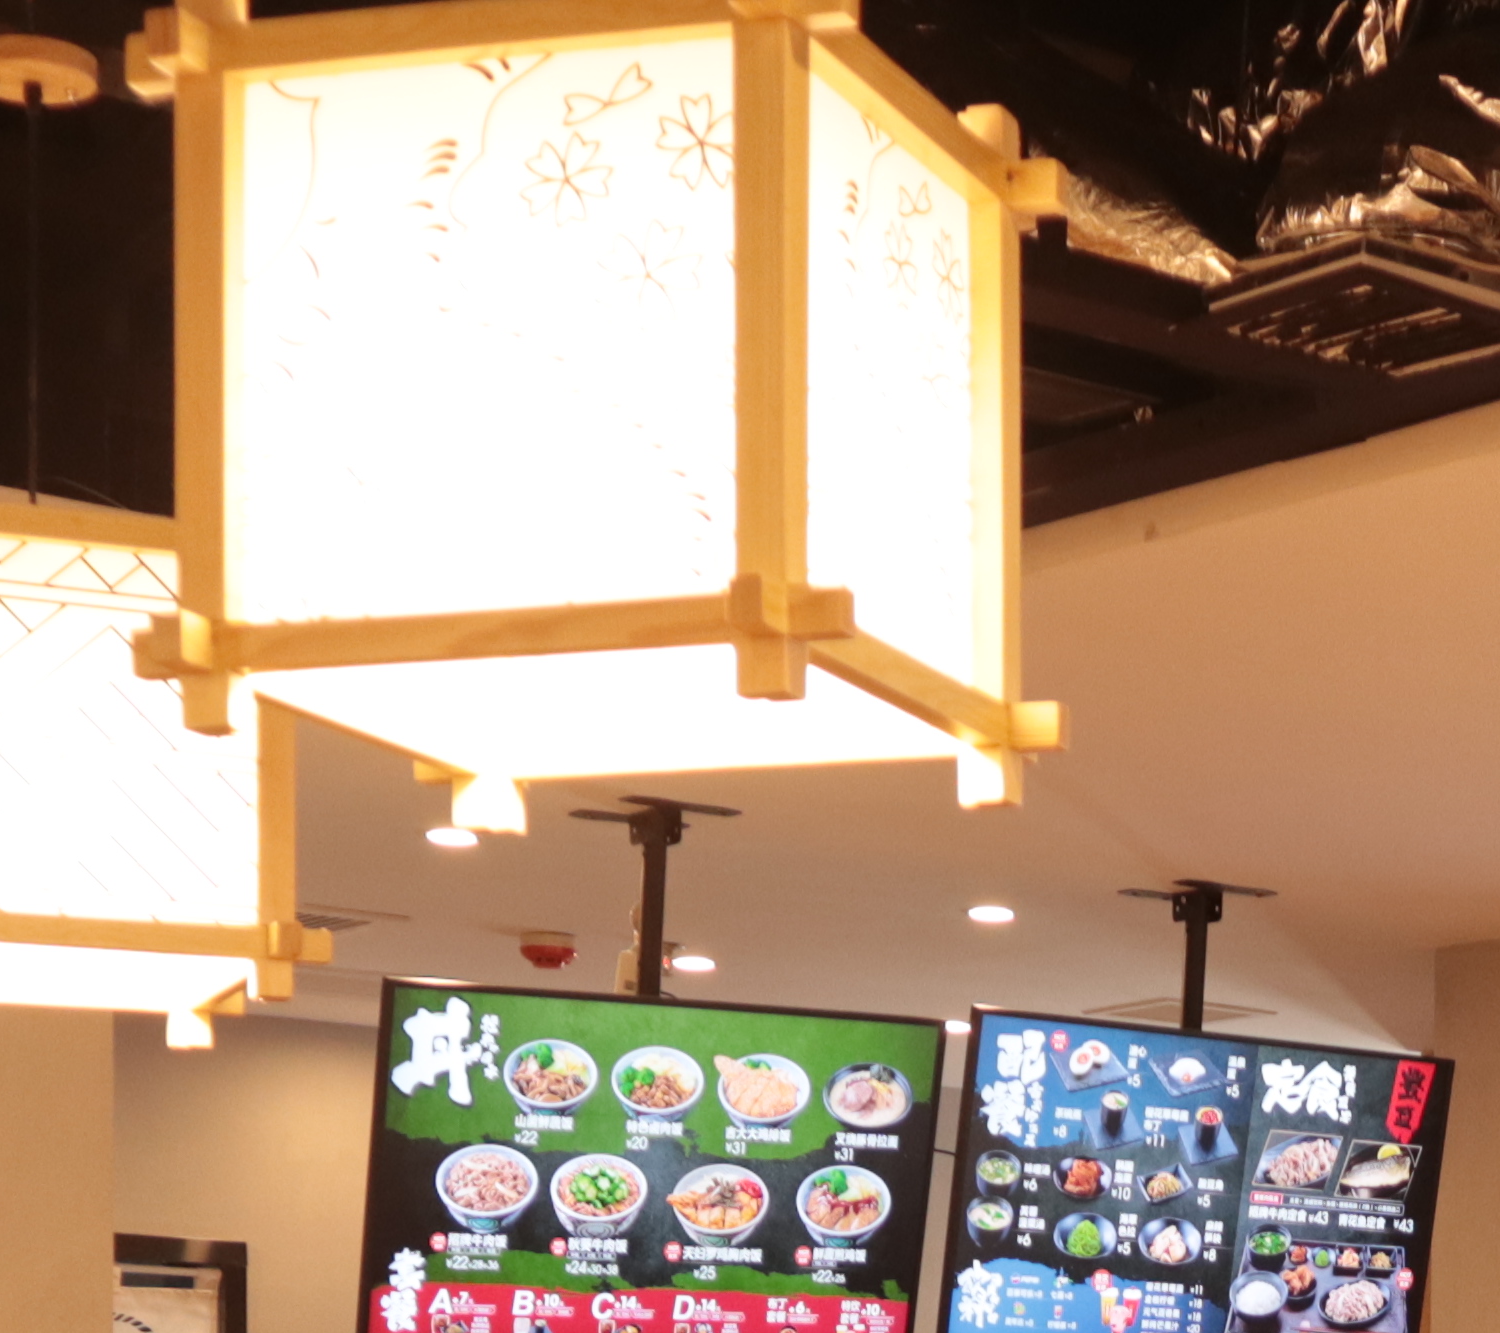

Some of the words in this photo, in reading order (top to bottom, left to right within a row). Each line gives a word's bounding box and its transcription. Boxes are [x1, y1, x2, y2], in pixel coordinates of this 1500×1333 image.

[514, 1131, 539, 1145] ¥22
[626, 1137, 648, 1150] ¥20
[1308, 1210, 1329, 1225] ¥43
[1393, 1218, 1414, 1234] ¥43
[693, 1266, 717, 1281] ¥25
[429, 1288, 454, 1314] A
[512, 1290, 535, 1315] B
[591, 1293, 615, 1320] C
[672, 1295, 696, 1320] D
